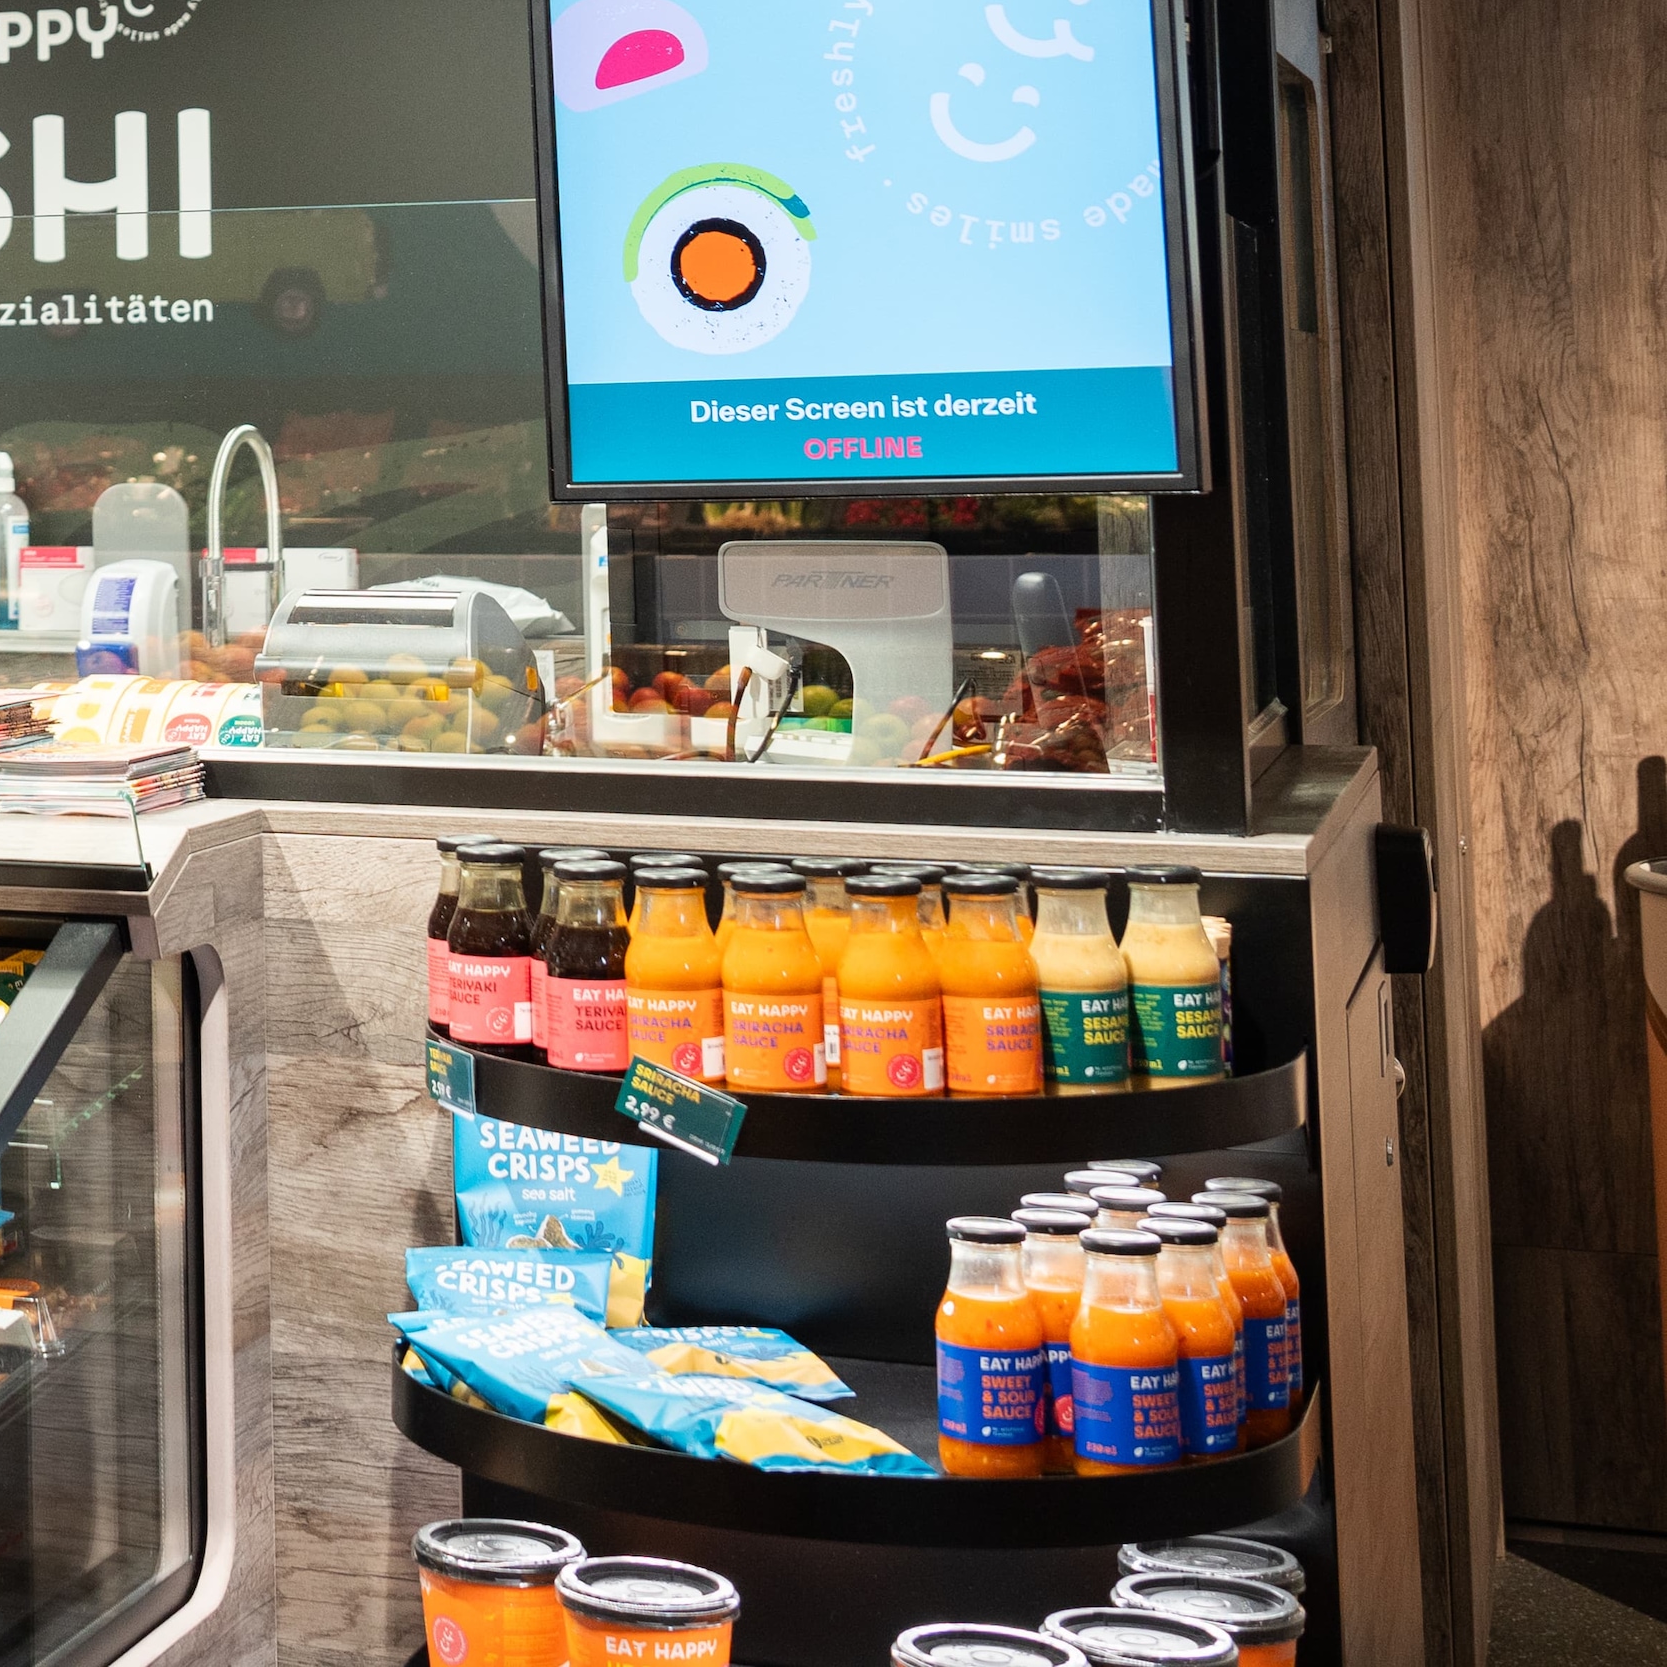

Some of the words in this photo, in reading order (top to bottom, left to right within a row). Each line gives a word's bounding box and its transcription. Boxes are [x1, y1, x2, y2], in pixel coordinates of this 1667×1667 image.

[905, 191, 1061, 249] smiles
[690, 398, 780, 425] Dieser
[785, 395, 886, 421] Screen
[892, 395, 929, 419] ist
[935, 391, 1038, 418] derzeit
[803, 437, 923, 461] OFFLINE
[465, 963, 511, 978] HAPPY
[572, 988, 602, 1002] EAT
[1173, 993, 1202, 1008] EAT
[647, 998, 697, 1012] HAPPY
[731, 1001, 755, 1015] EAT
[758, 1004, 808, 1017] HAPPY
[1081, 999, 1111, 1014] EAT
[575, 1019, 623, 1031] SAUCE
[732, 1019, 804, 1034] SRIRACHA
[733, 1034, 778, 1049] SAUCE
[1084, 1031, 1127, 1045] SAUCE
[630, 1077, 676, 1106] SAUCE
[635, 1063, 702, 1105] SRIRACHA
[624, 1095, 661, 1122] 2,99
[662, 1114, 677, 1130] €
[487, 1152, 591, 1183] CRISPS
[522, 1188, 546, 1201] sea
[549, 1187, 576, 1202] salt
[436, 1270, 542, 1303] CRISPS
[979, 1356, 1011, 1371] EAT
[981, 1375, 1032, 1389] SWEET
[1130, 1375, 1161, 1390] EAT
[982, 1390, 993, 1404] &
[998, 1390, 1036, 1405] SOUR
[982, 1405, 1032, 1420] SAUCE
[605, 1635, 647, 1658] EAT
[654, 1638, 718, 1660] HAPPY
